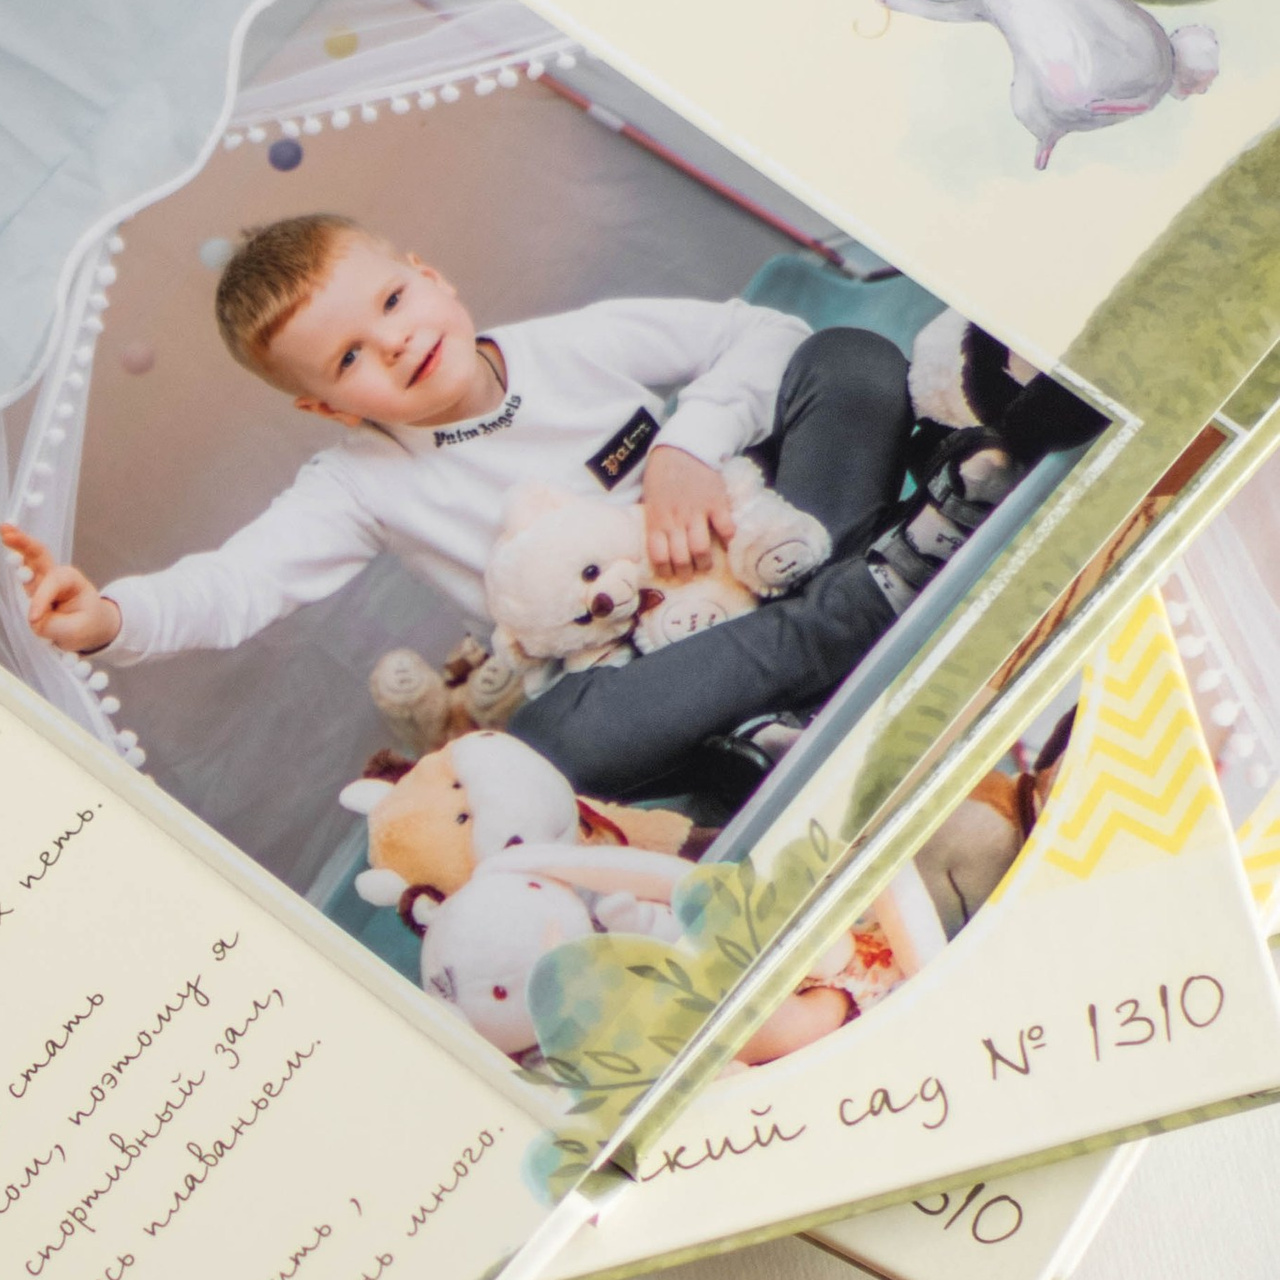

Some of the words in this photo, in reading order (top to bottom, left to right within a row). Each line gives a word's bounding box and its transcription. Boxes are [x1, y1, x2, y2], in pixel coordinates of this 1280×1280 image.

[20, 802, 103, 889] петь.
[9, 993, 104, 1099] стать
[69, 975, 210, 1126] поэтому
[213, 932, 239, 961] я
[641, 1105, 806, 1182] кий
[840, 1077, 949, 1129] сад
[1089, 975, 1223, 1061] 1310
[26, 1071, 206, 1276] спортивный
[215, 989, 284, 1070] зал,
[144, 1040, 322, 1237] плаваньем.
[407, 1125, 505, 1238] много.
